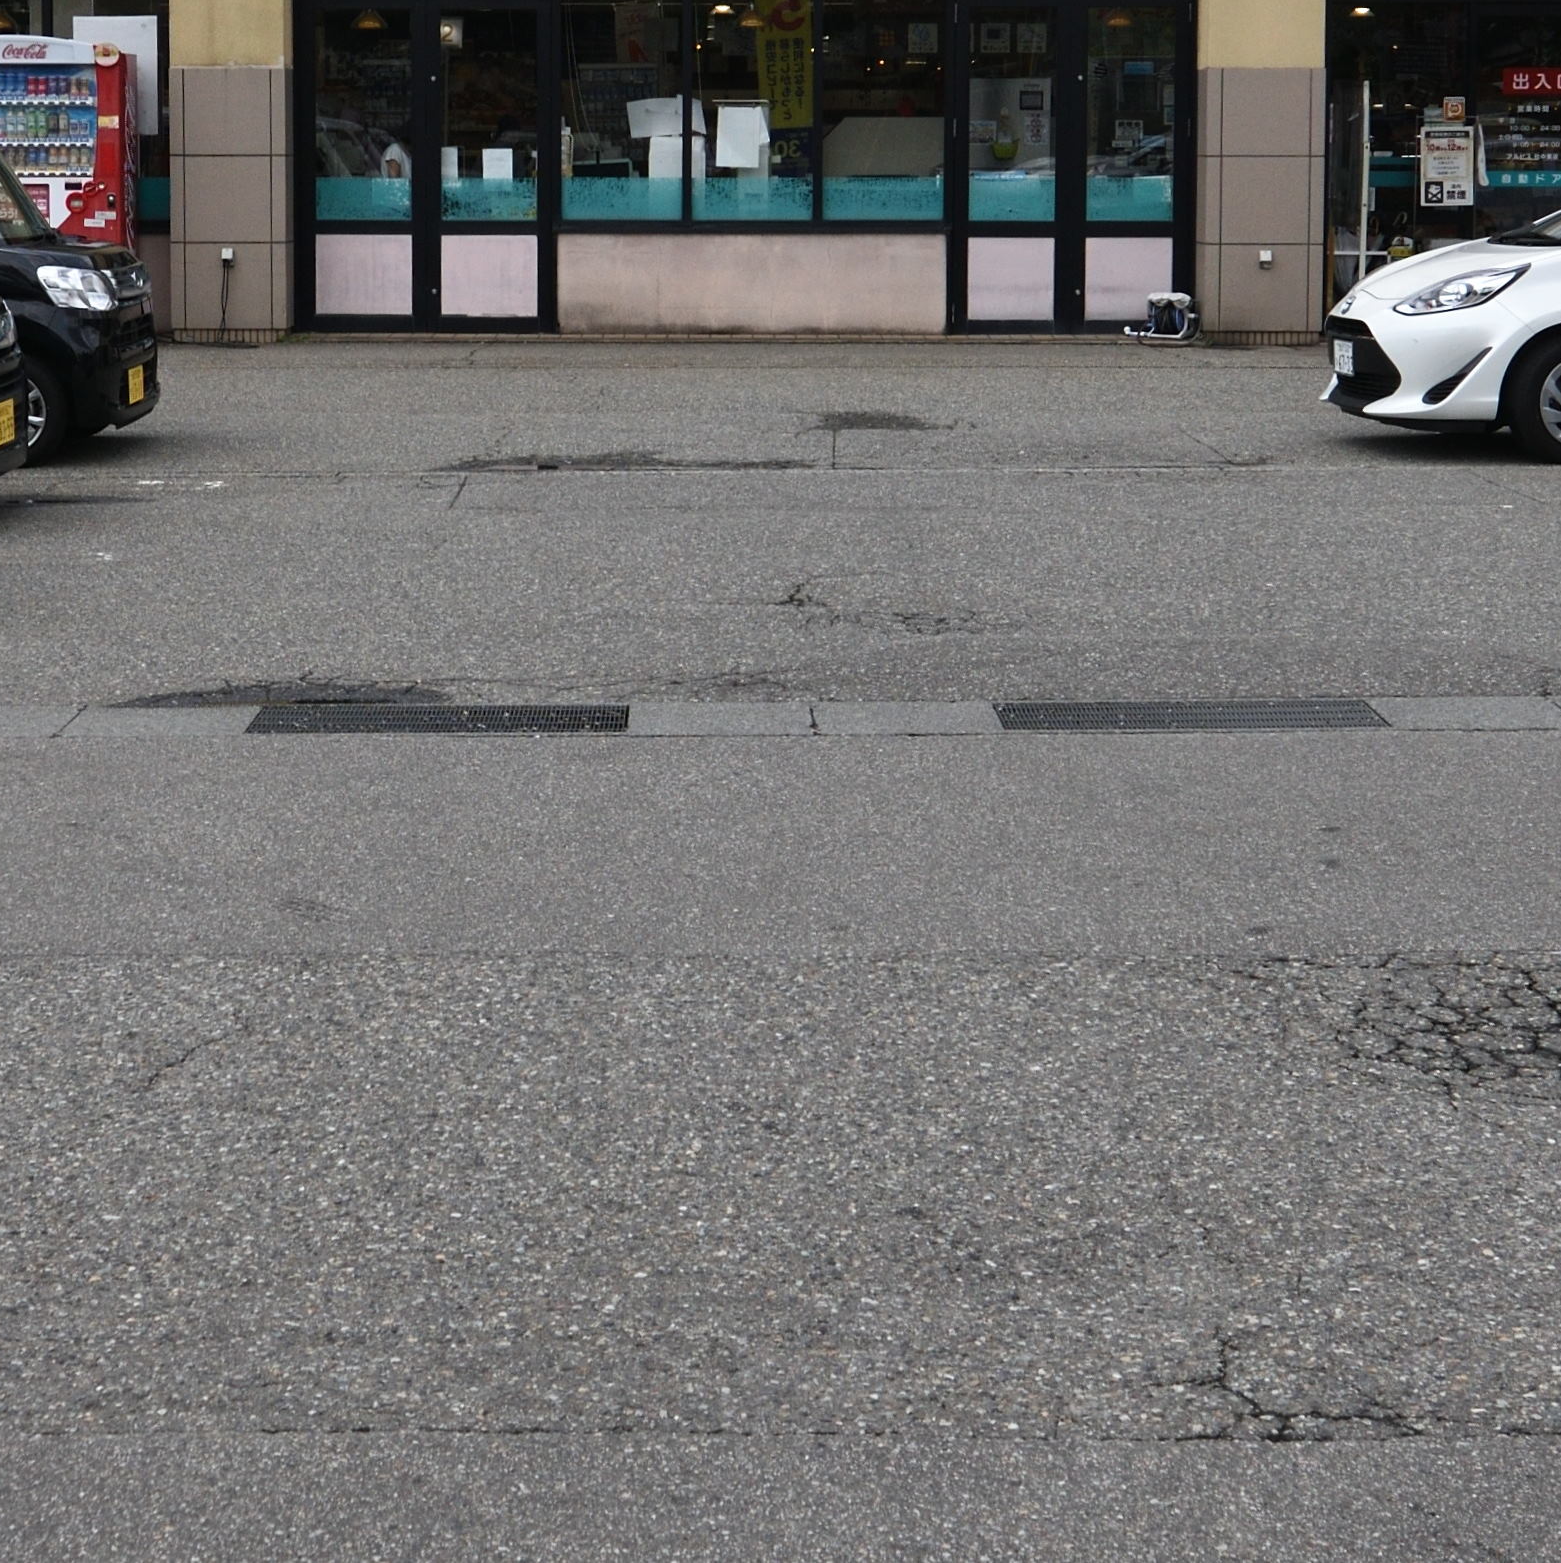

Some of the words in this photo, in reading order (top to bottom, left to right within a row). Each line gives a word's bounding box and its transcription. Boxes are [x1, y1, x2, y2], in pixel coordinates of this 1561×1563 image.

[440, 22, 454, 43] 2
[1502, 174, 1561, 184] 自動ドア
